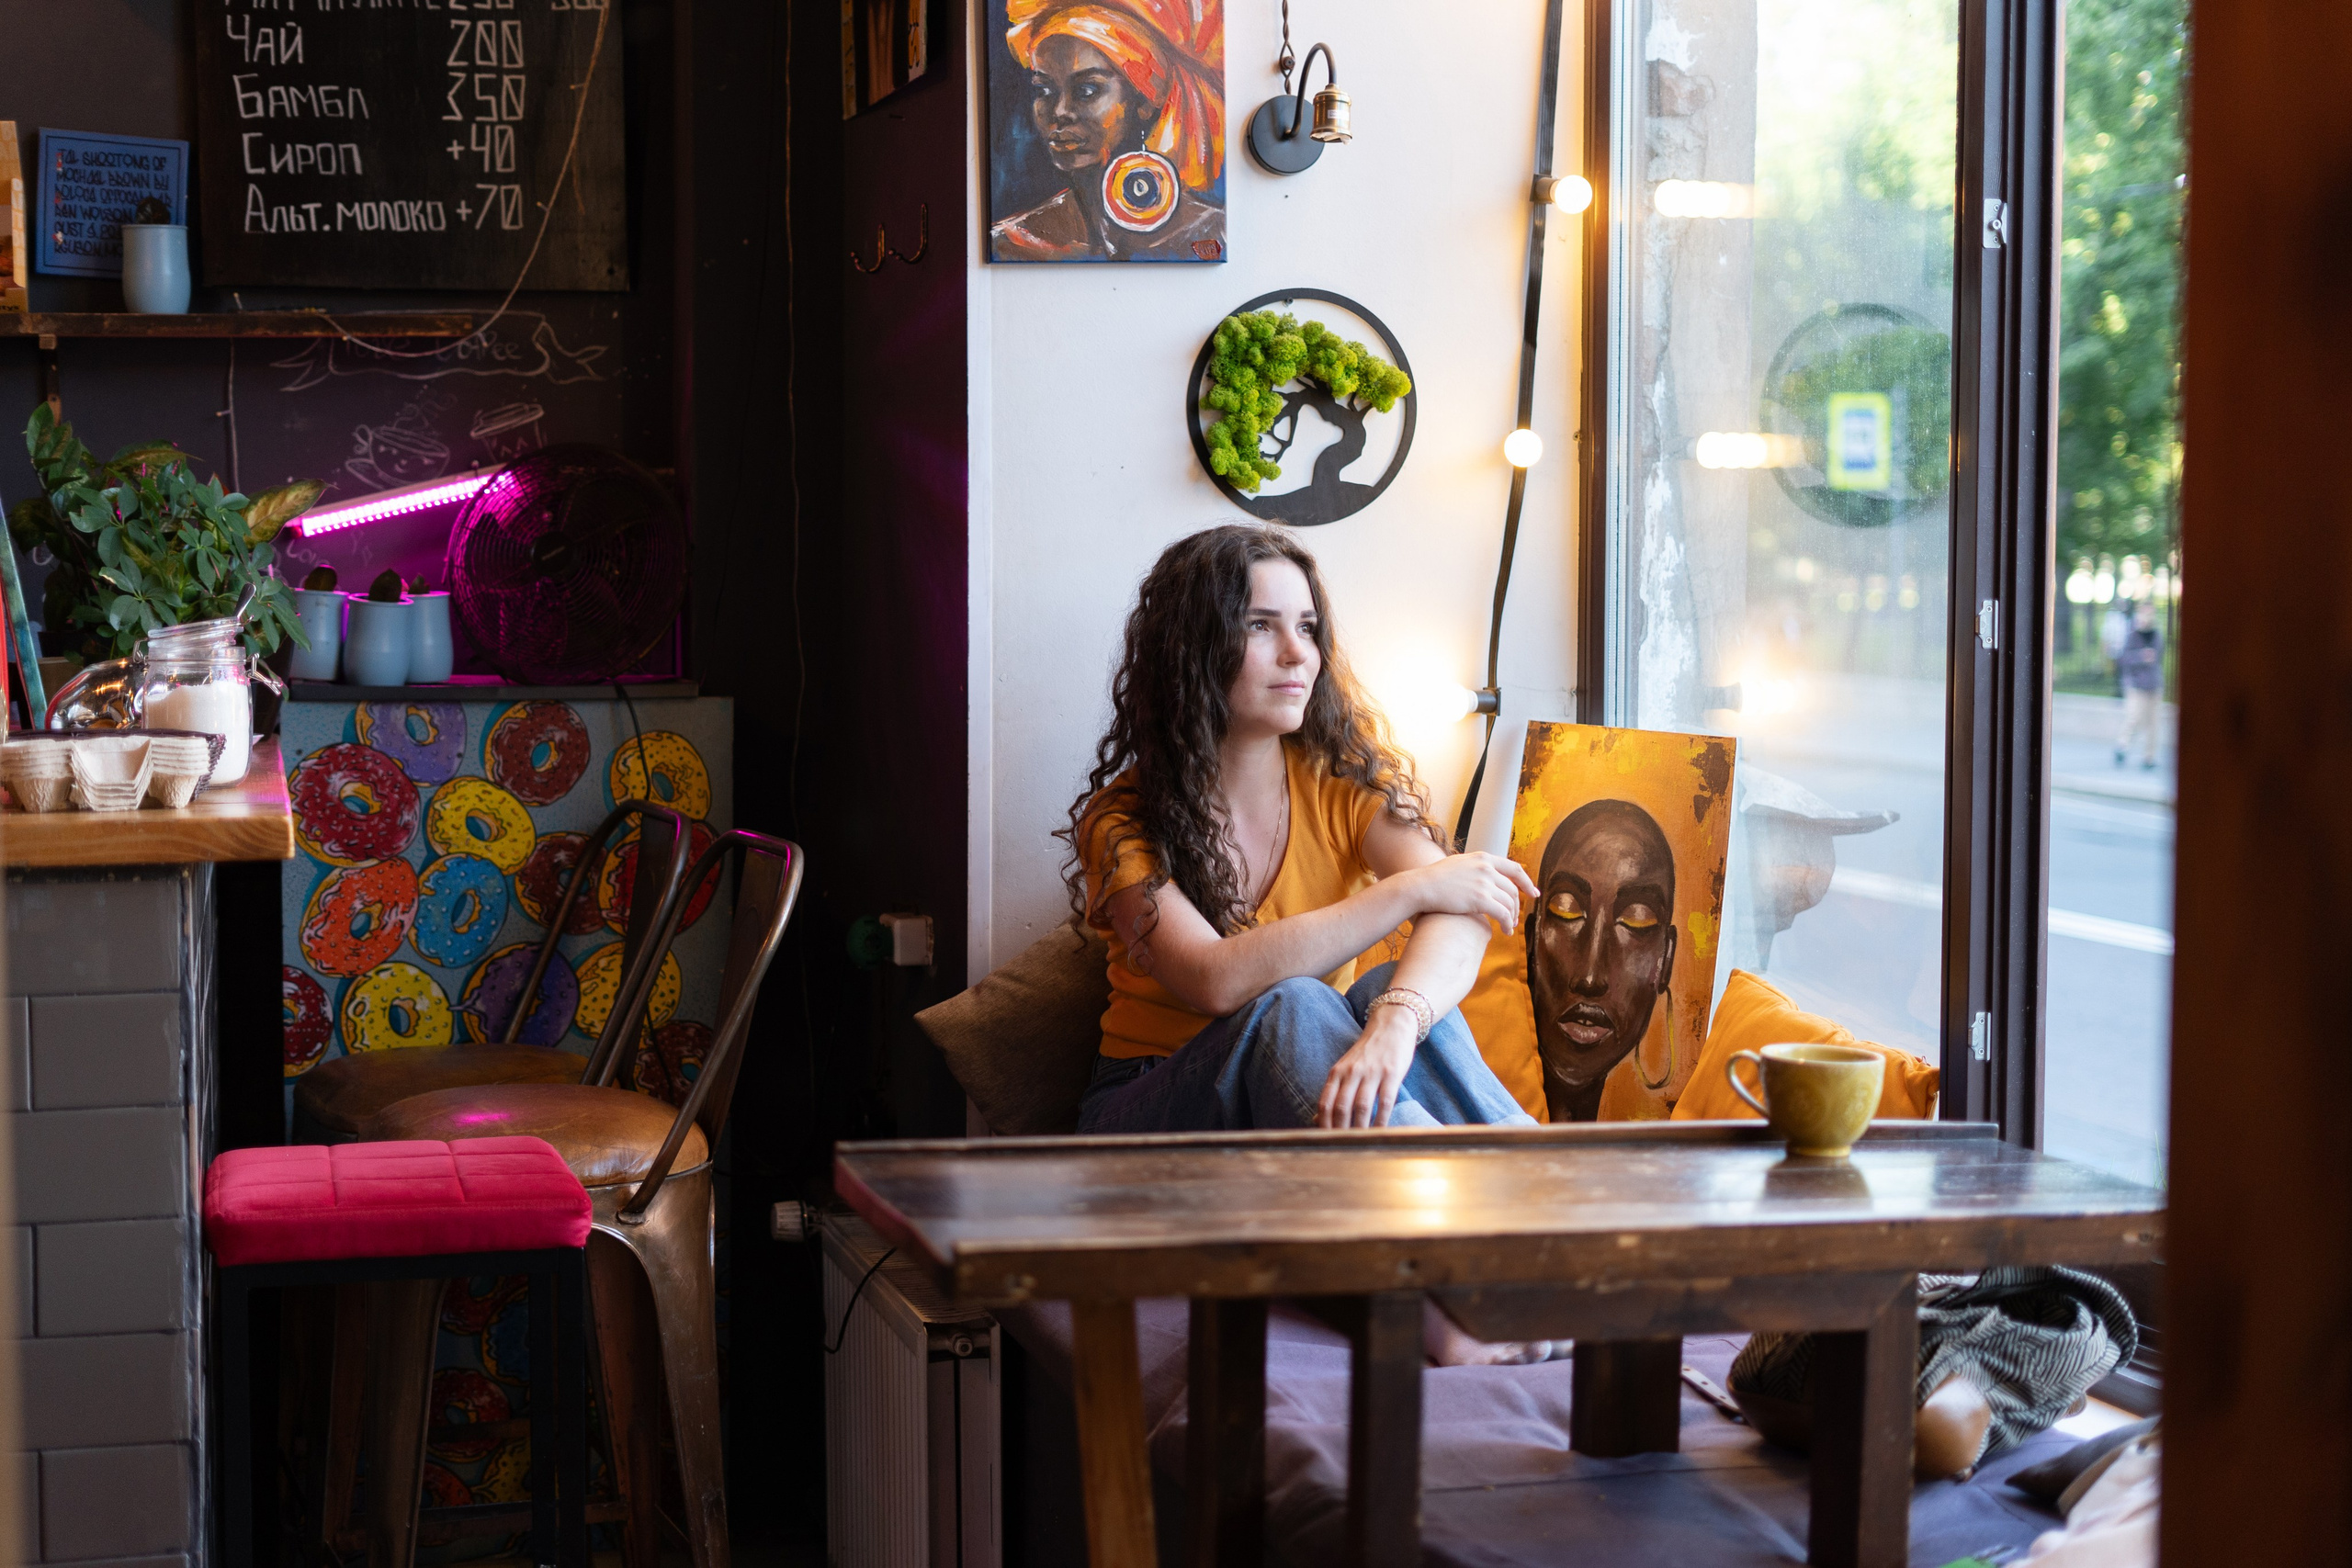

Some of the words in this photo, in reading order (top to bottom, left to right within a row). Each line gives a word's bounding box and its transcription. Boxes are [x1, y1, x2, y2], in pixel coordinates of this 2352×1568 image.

[447, 19, 525, 68] 200
[442, 72, 526, 121] 350
[446, 123, 515, 173] +40
[456, 184, 524, 231] +70
